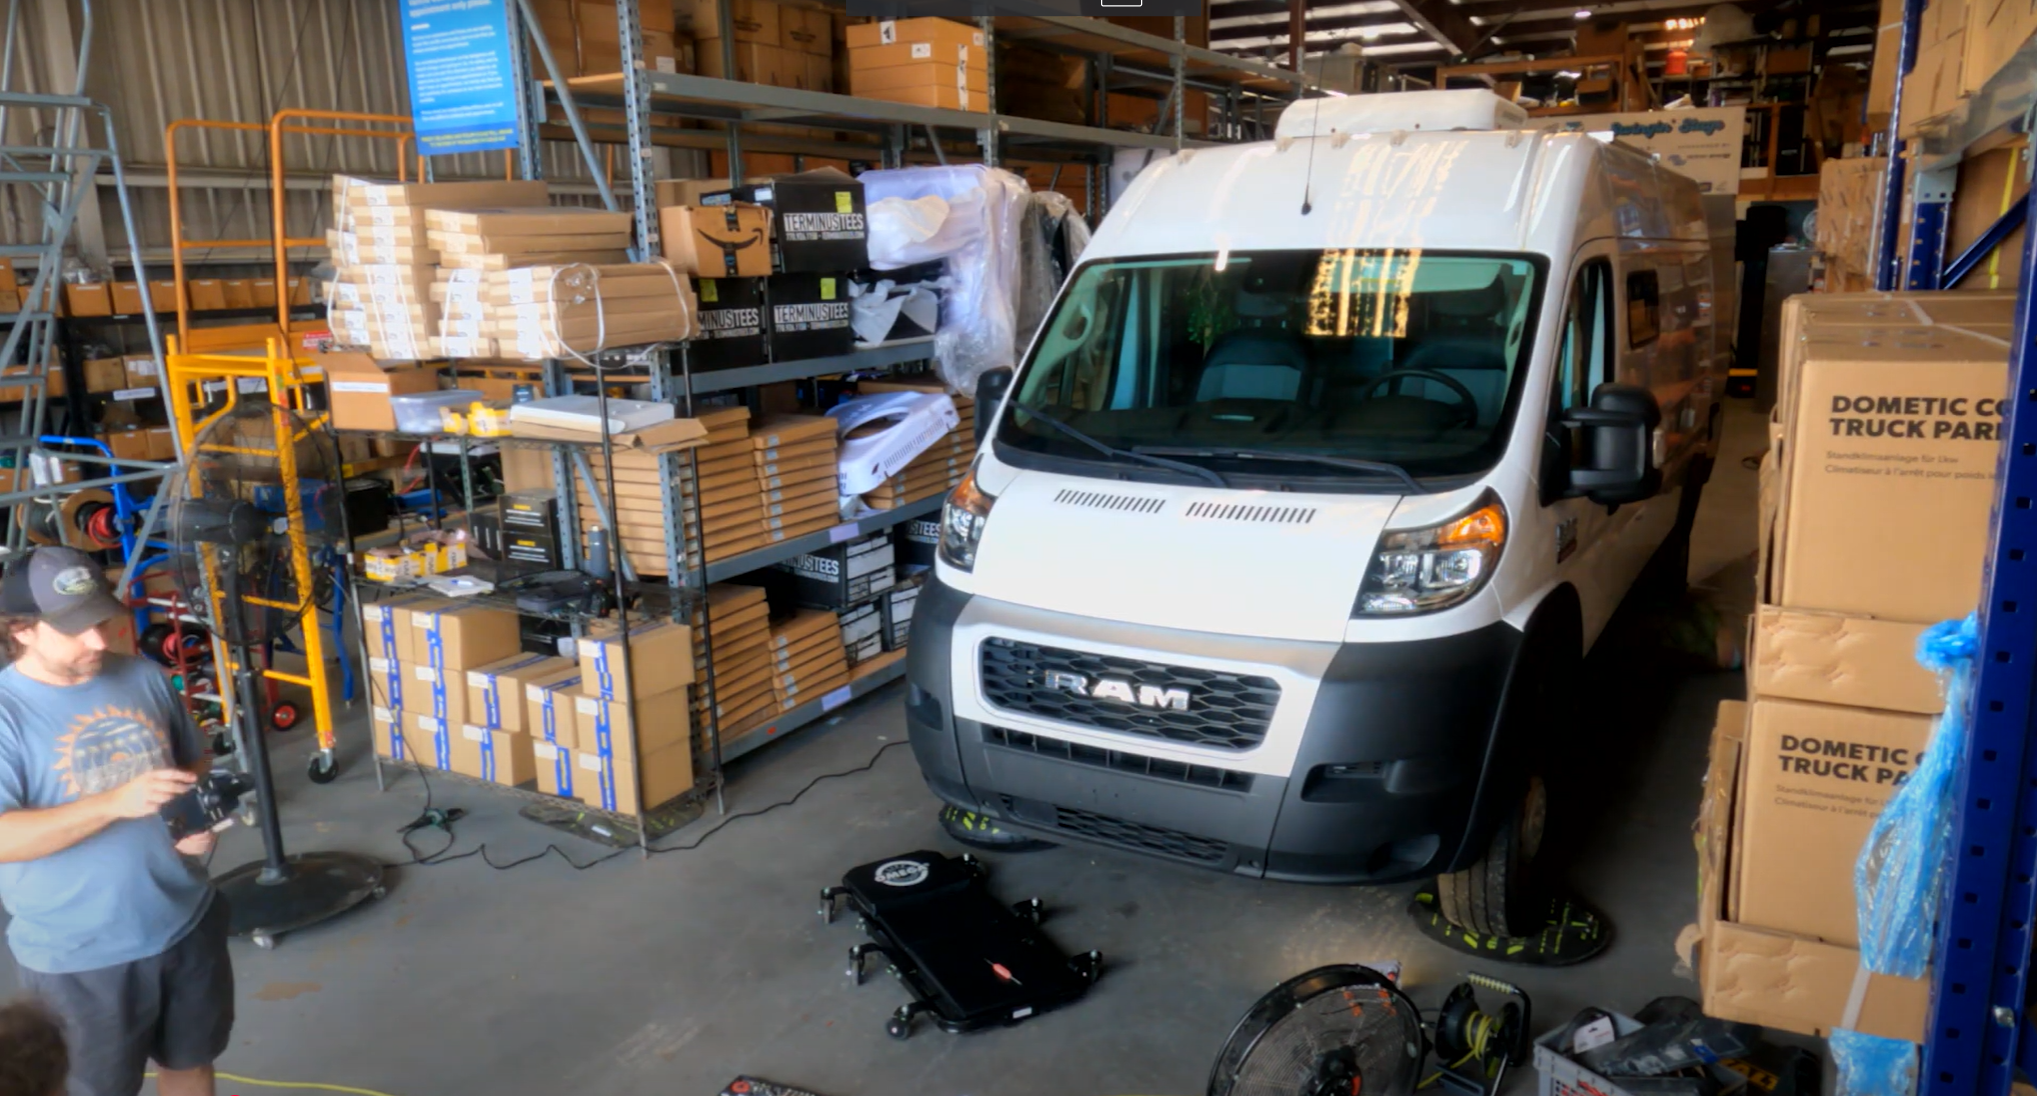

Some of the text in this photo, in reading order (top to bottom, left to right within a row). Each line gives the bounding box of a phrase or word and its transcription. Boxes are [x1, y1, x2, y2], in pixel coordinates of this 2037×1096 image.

[783, 212, 864, 232] TERMINUSTEES
[773, 302, 849, 323] TERMINUSTEES
[1831, 396, 1968, 416] DOMETIC
[1829, 417, 1927, 438] TRUCK
[1826, 450, 1919, 464] Standklimaanlage
[1825, 464, 1883, 474] Climatiseur
[1926, 470, 1952, 480] pour
[1045, 669, 1190, 711] RAM
[1781, 734, 1909, 766] DOMETIC
[1778, 754, 1869, 782] TRUCK
